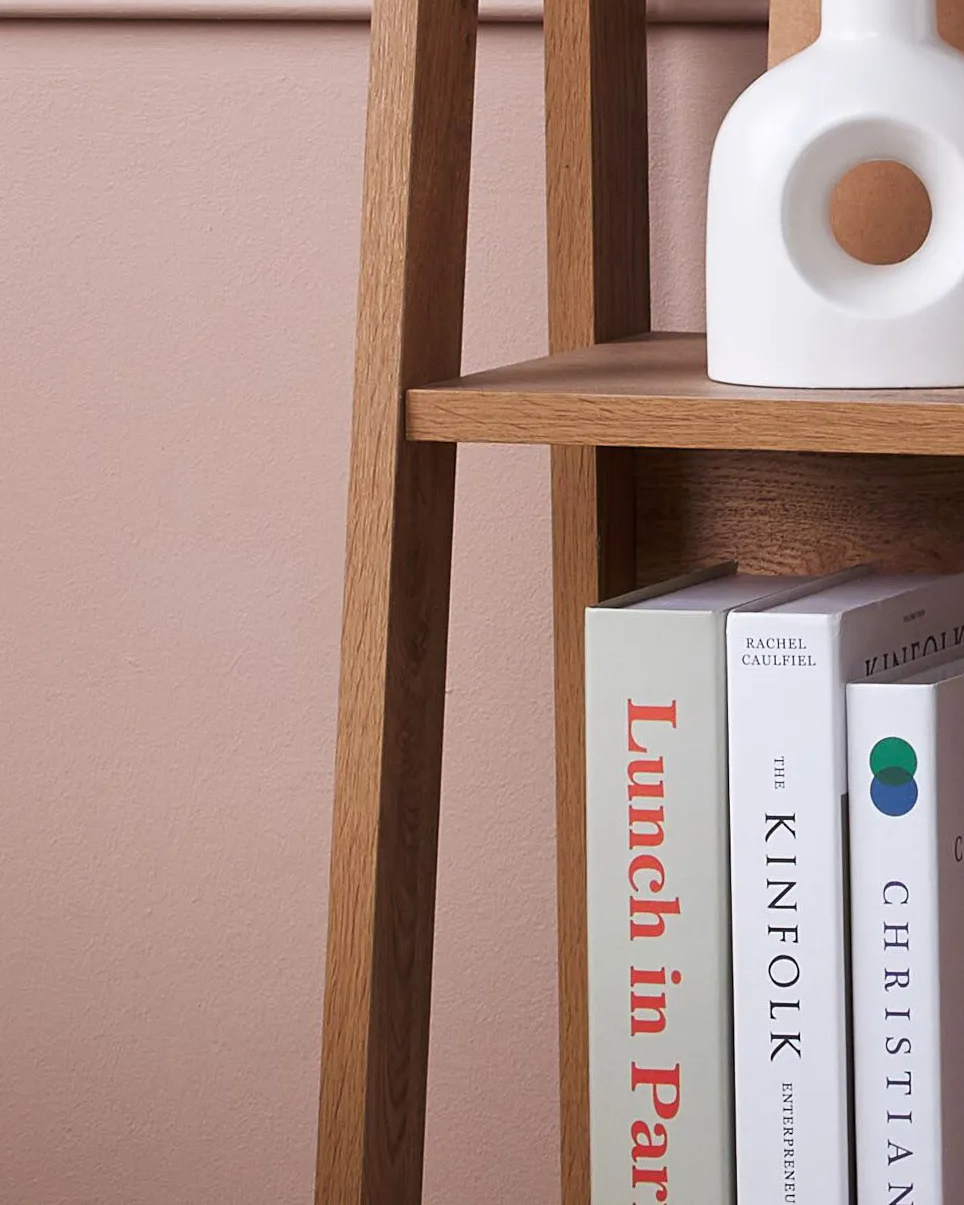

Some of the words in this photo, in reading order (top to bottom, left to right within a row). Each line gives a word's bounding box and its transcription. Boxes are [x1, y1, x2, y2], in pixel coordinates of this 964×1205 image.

[741, 653, 817, 667] CAULFIEL
[746, 637, 807, 649] RACHEL
[773, 755, 786, 790] THE
[626, 697, 682, 941] Lunch
[764, 812, 802, 1062] KINFOLK
[629, 964, 682, 1037] in
[629, 1060, 682, 1205] Par
